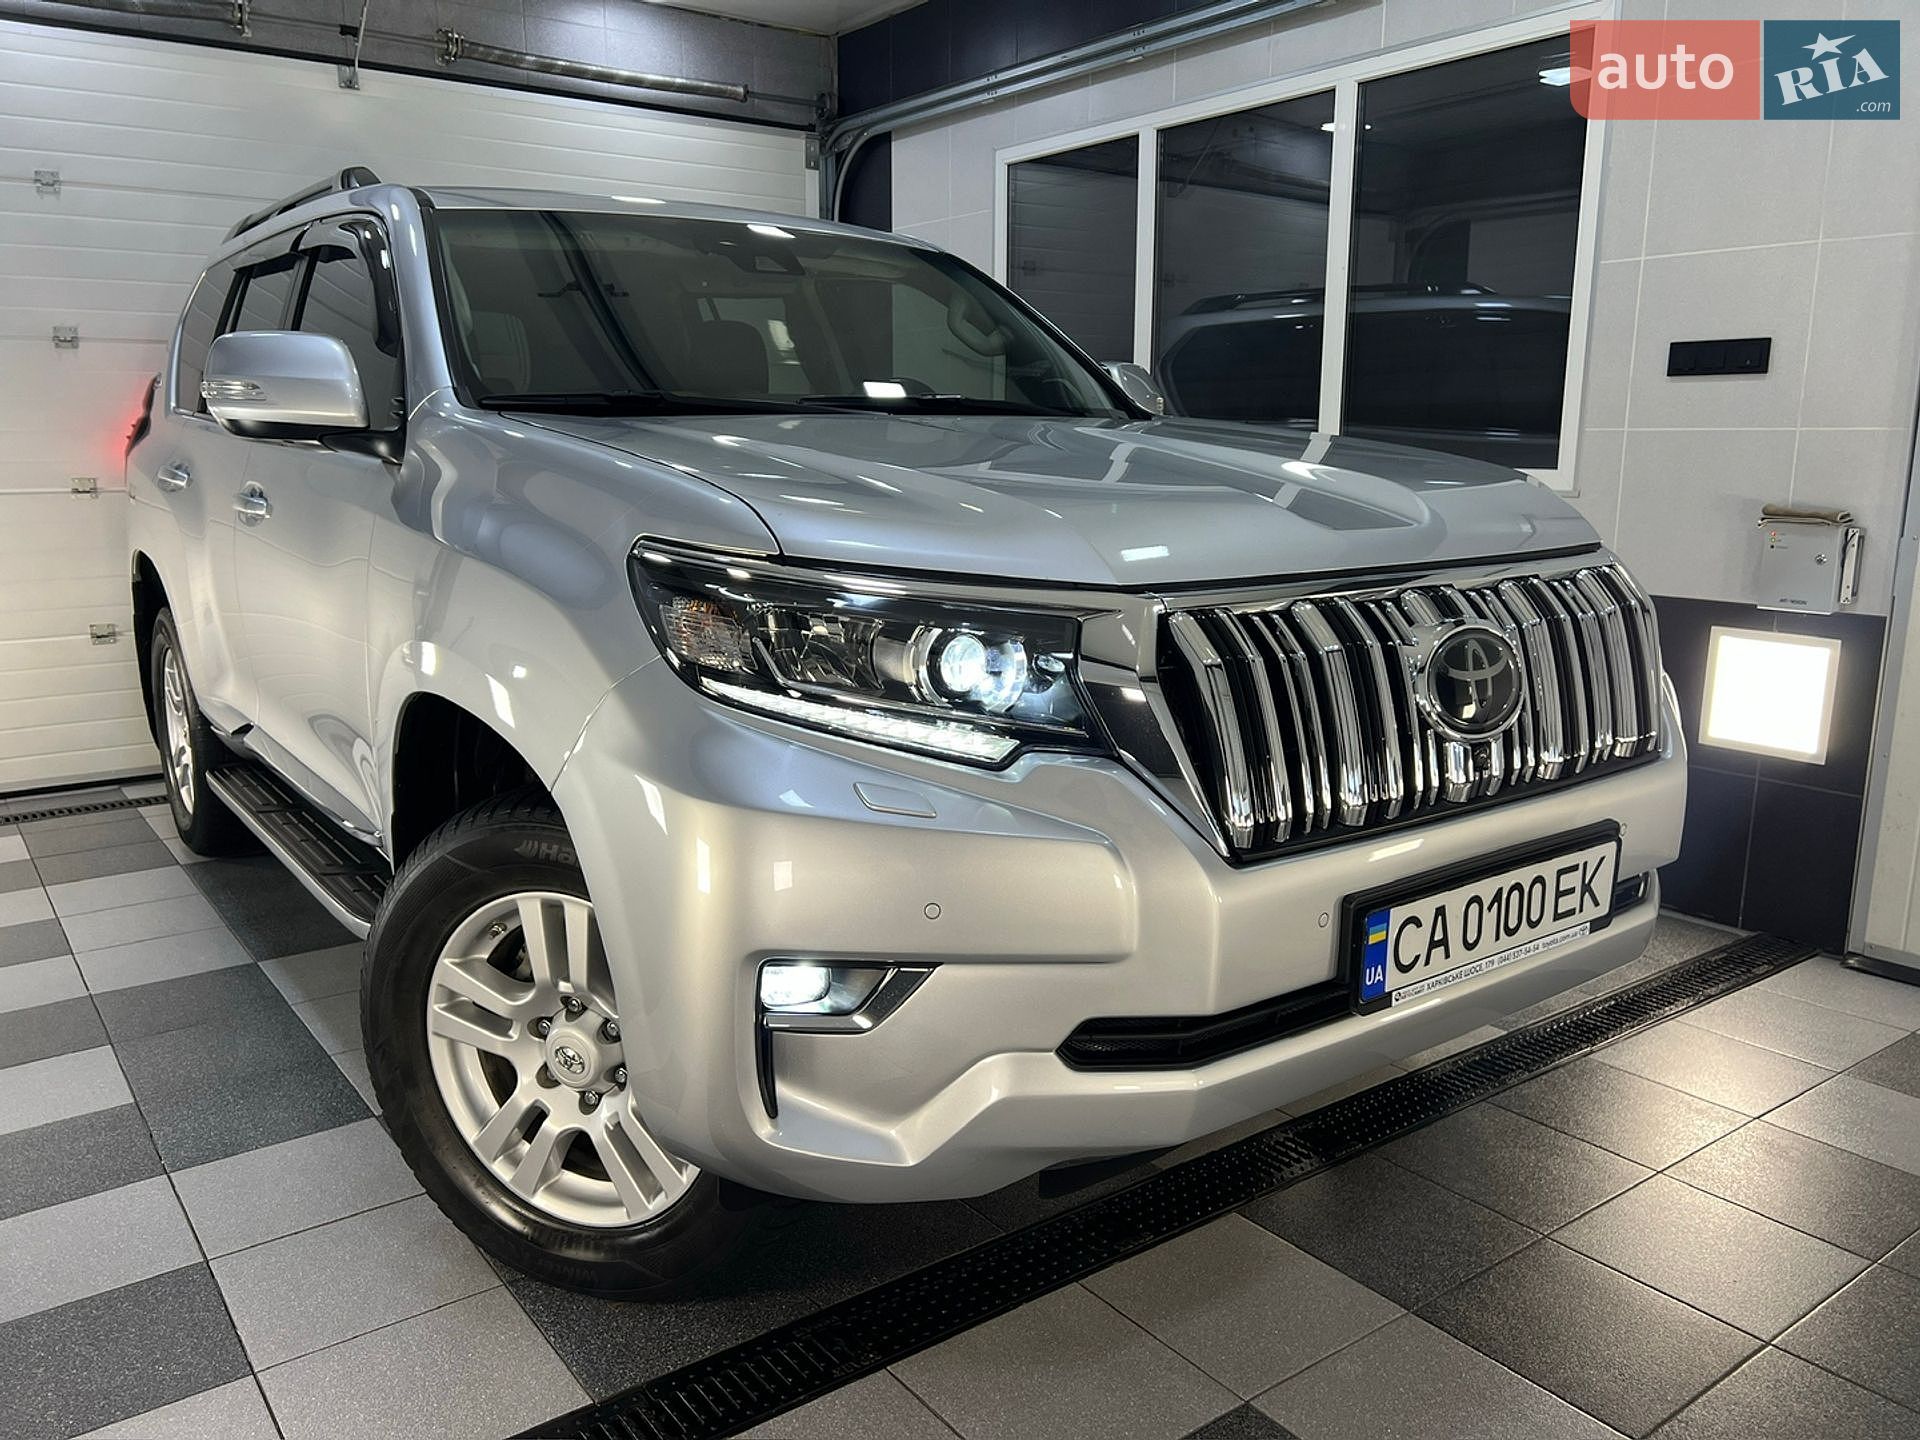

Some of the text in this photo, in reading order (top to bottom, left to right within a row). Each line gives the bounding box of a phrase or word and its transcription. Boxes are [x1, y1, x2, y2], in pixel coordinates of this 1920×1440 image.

[1393, 855, 1606, 974] CA 0100 EK
[1365, 964, 1384, 986] UA
